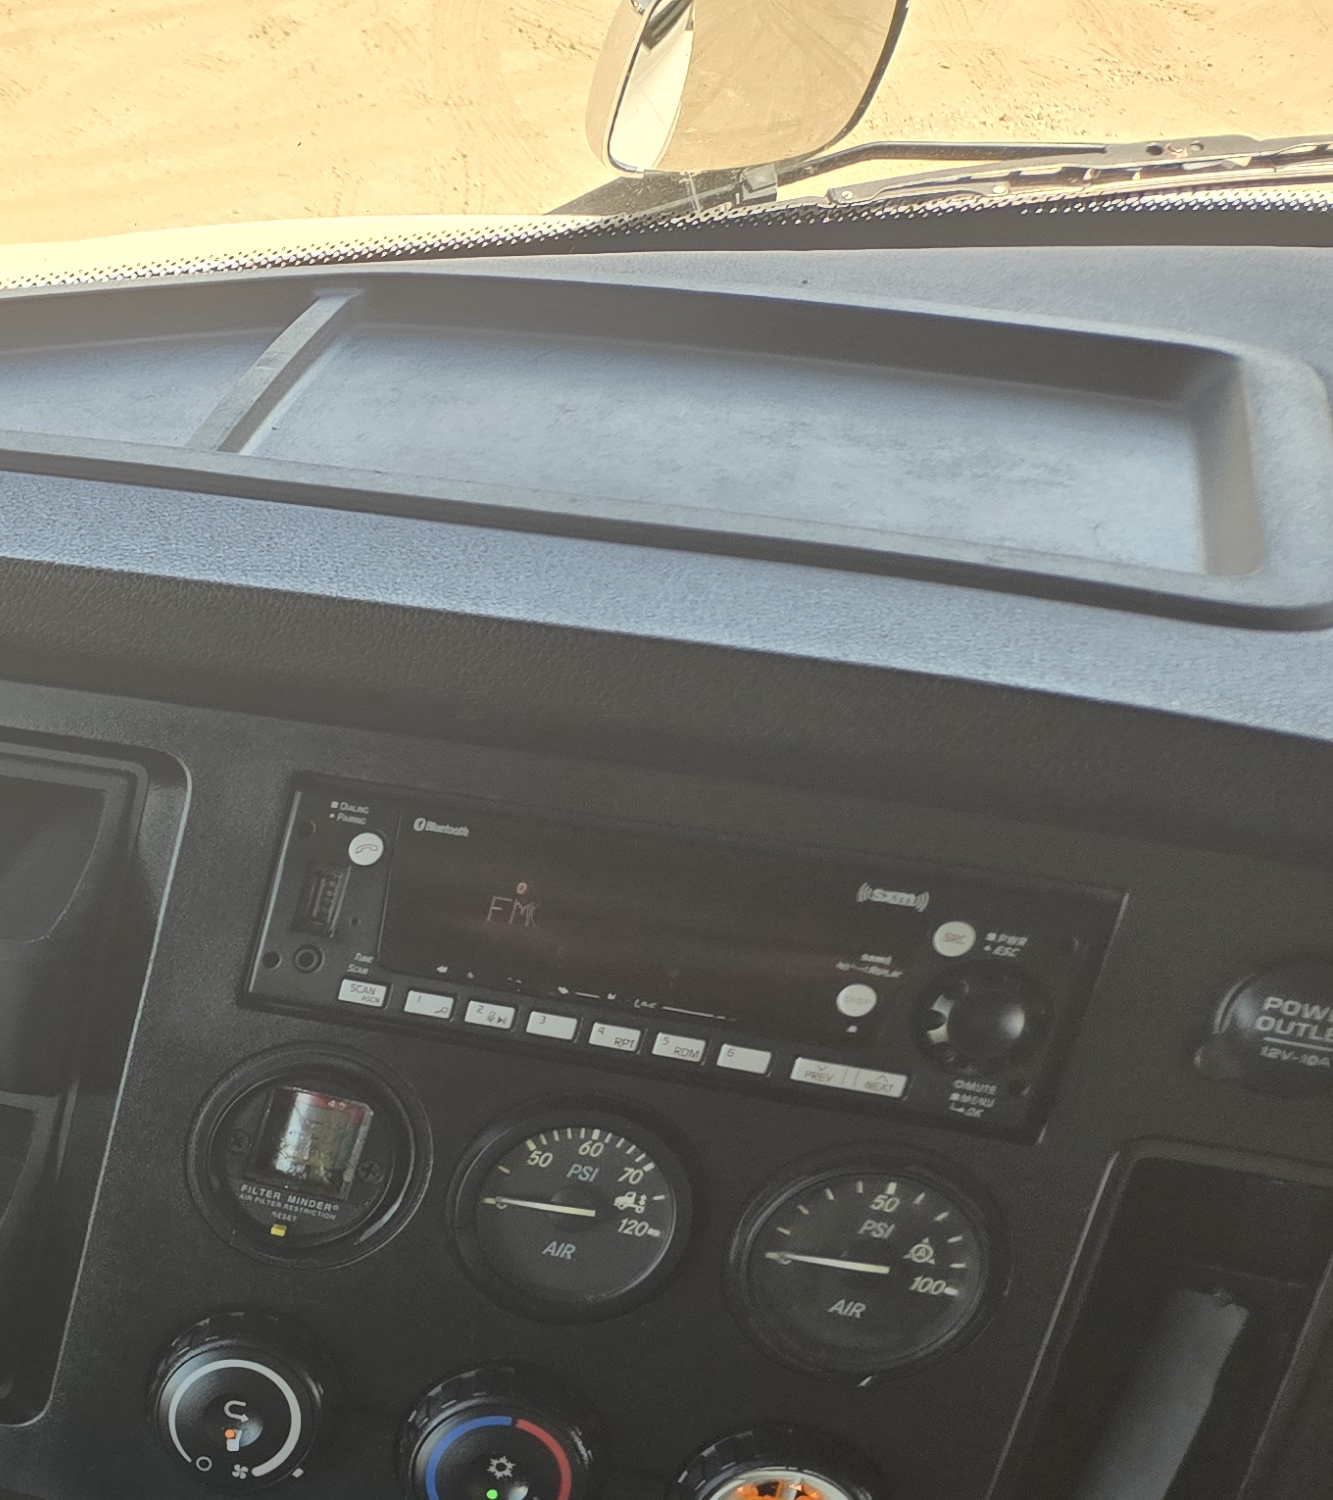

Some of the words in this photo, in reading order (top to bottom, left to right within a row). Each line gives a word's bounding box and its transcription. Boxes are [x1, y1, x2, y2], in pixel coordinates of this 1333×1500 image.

[349, 983, 377, 995] SCAN
[614, 1036, 635, 1049] RPT
[673, 1046, 700, 1058] RDM
[804, 1070, 835, 1082] PREV
[864, 1080, 895, 1093] NEXT
[578, 1141, 604, 1157] 60
[527, 1152, 553, 1168] 50
[566, 1164, 599, 1182] PSI
[617, 1168, 643, 1185] 70
[240, 1184, 282, 1201] FILTER
[238, 1193, 254, 1202] AIR
[255, 1195, 282, 1208] FILTER
[283, 1203, 337, 1221] RESTRICTION
[870, 1195, 900, 1212] 50
[271, 1211, 298, 1223] RESET
[617, 1219, 648, 1237] 120
[858, 1220, 895, 1239] PSI
[542, 1241, 576, 1259] AIR
[909, 1276, 946, 1295] 100
[828, 1299, 866, 1318] AIR
